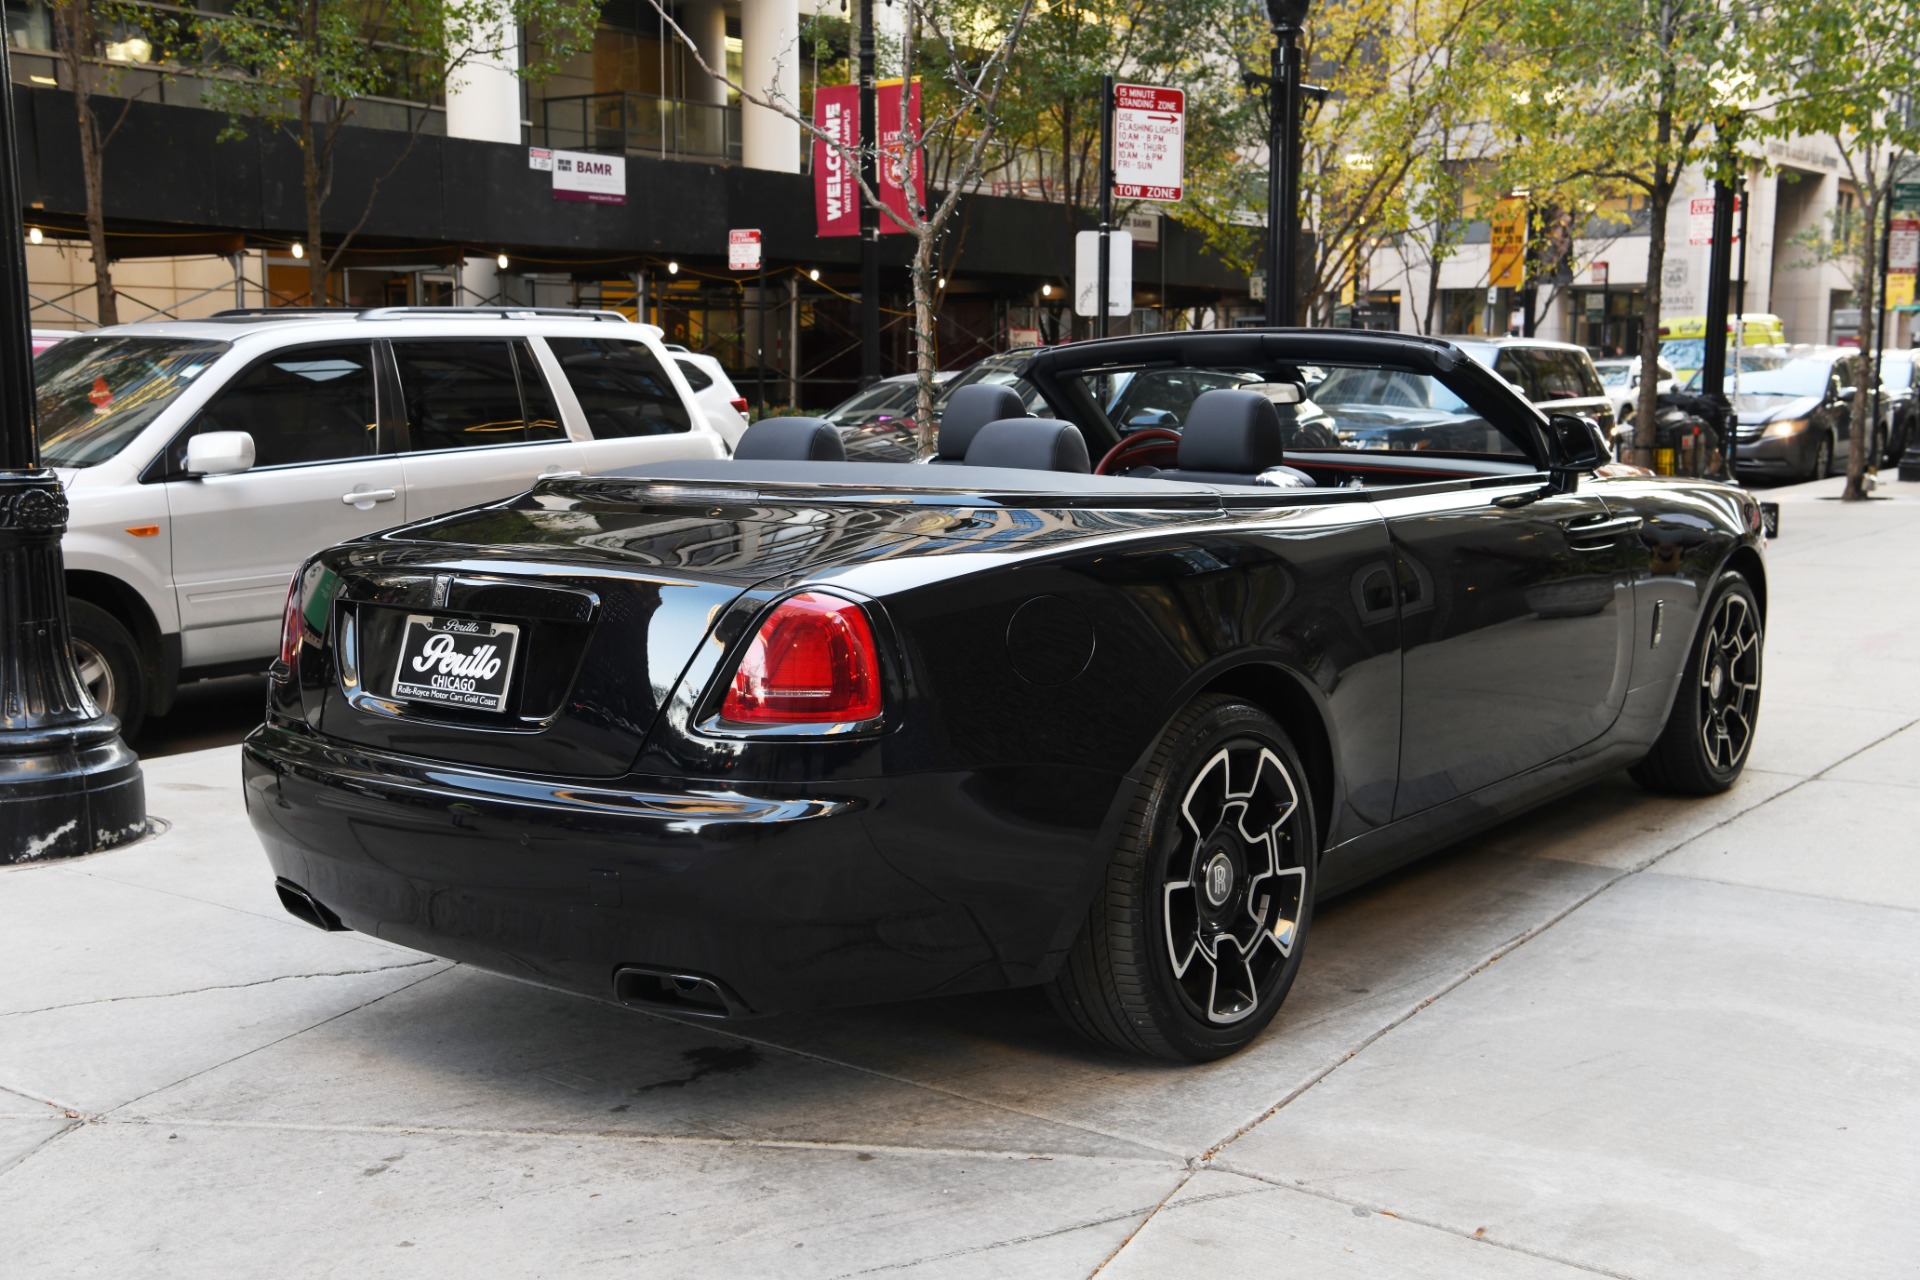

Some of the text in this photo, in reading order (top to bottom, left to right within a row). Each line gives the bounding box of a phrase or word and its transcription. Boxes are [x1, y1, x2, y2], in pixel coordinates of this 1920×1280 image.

[1119, 88, 1156, 99] 15 MINUTE
[1119, 98, 1177, 111] STANDING ZONE
[1118, 113, 1133, 121] USE
[843, 108, 851, 148] CAMPUS
[1118, 122, 1179, 135] FLASHING LIGHTS
[1153, 134, 1164, 142] PM
[1118, 141, 1134, 150] MON
[1143, 143, 1167, 152] THURS
[576, 160, 613, 177] BAMR
[825, 102, 842, 222] WELCOME
[1117, 160, 1130, 168] FRI
[1137, 161, 1153, 170] SUN
[843, 183, 852, 214] WATER
[1118, 184, 1176, 199] TOW ZONE
[443, 619, 480, 633] Perillo
[412, 633, 501, 680] Perillo
[431, 674, 476, 692] CHICAGO
[397, 685, 497, 707] Rolls-Royce Motor Cars Gold Coast
